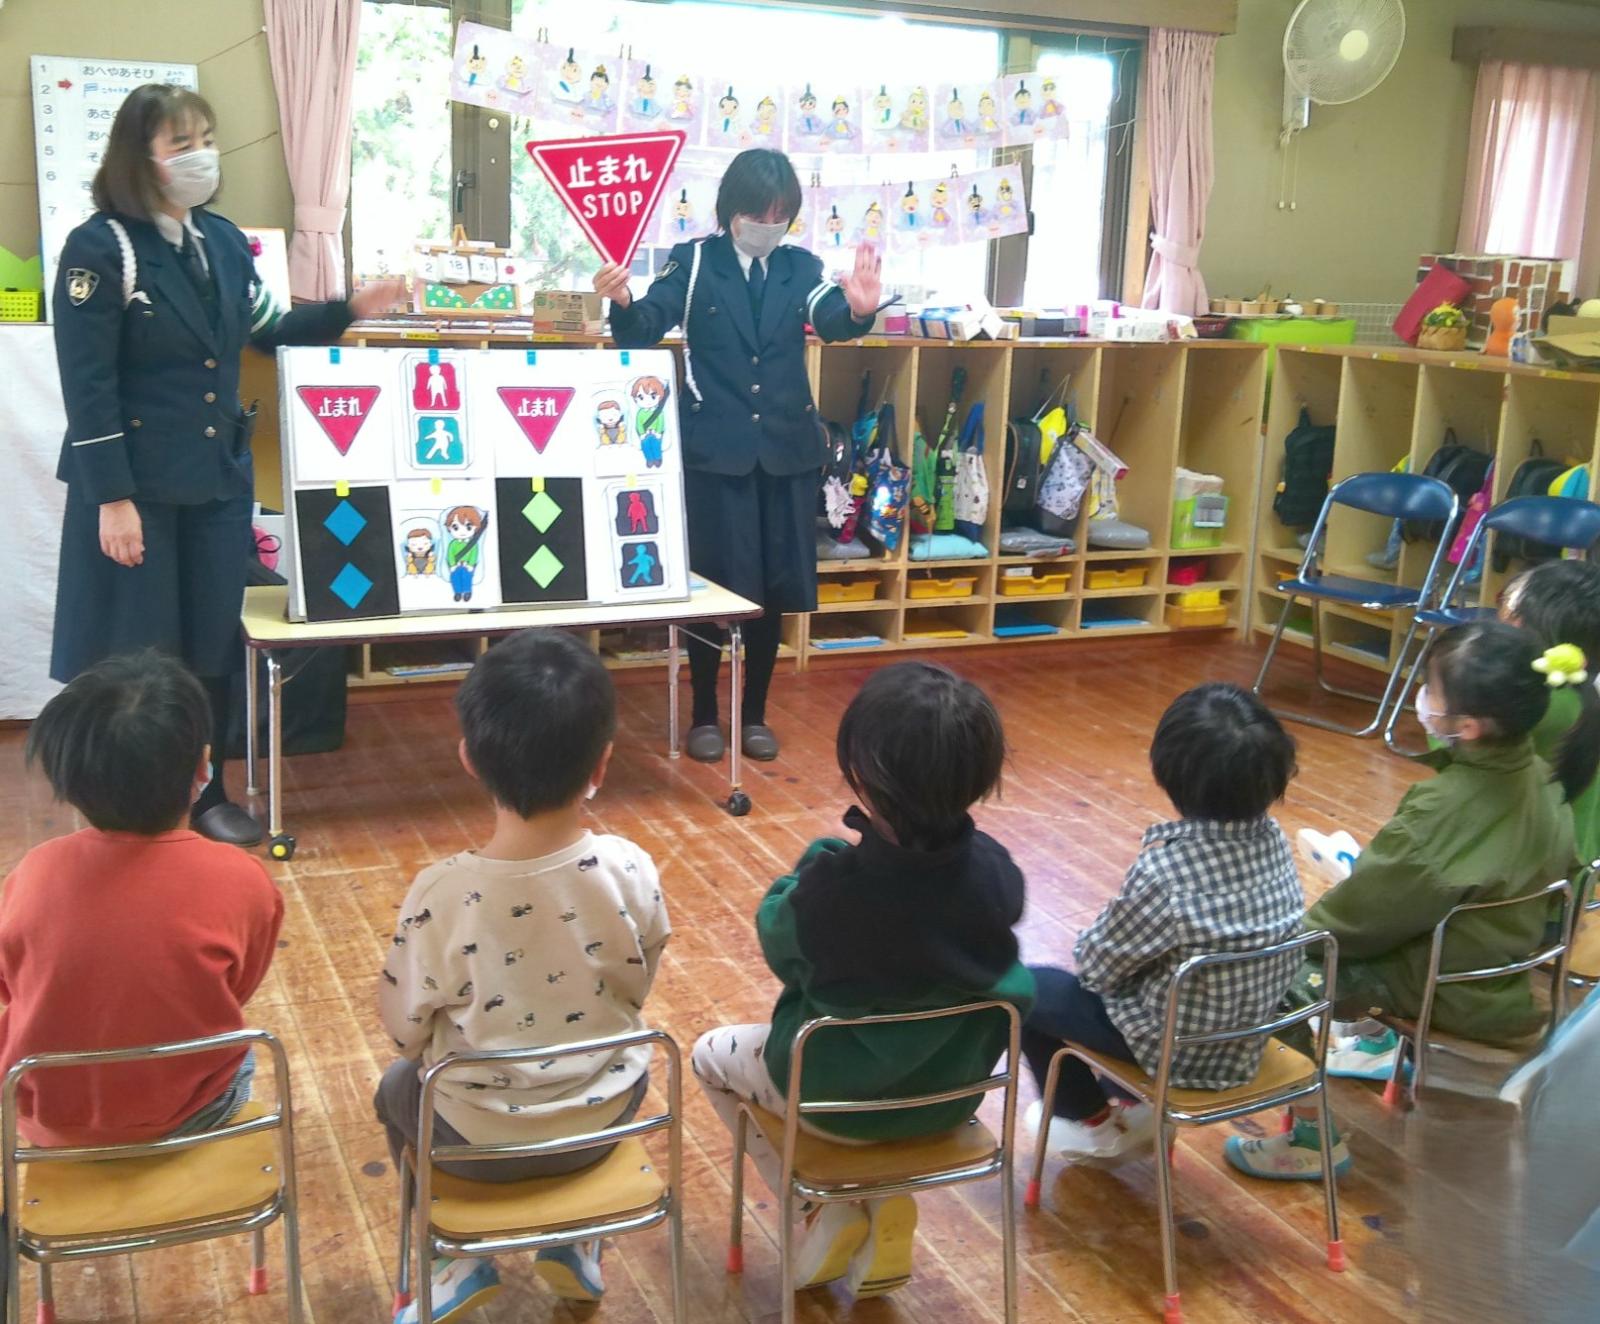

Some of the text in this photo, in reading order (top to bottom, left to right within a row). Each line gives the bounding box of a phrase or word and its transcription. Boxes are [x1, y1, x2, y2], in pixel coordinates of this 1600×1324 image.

[83, 66, 154, 79] おへやあそび
[41, 85, 50, 95] 2
[43, 104, 53, 115] 3
[43, 124, 54, 134] 4
[45, 146, 54, 156] 5
[46, 170, 56, 181] 6
[566, 153, 653, 188] 止まれ
[582, 190, 643, 219] STOP
[47, 205, 57, 216] 7
[425, 262, 433, 273] 2
[318, 397, 363, 417] 止まれ
[517, 398, 559, 417] 止まれ
